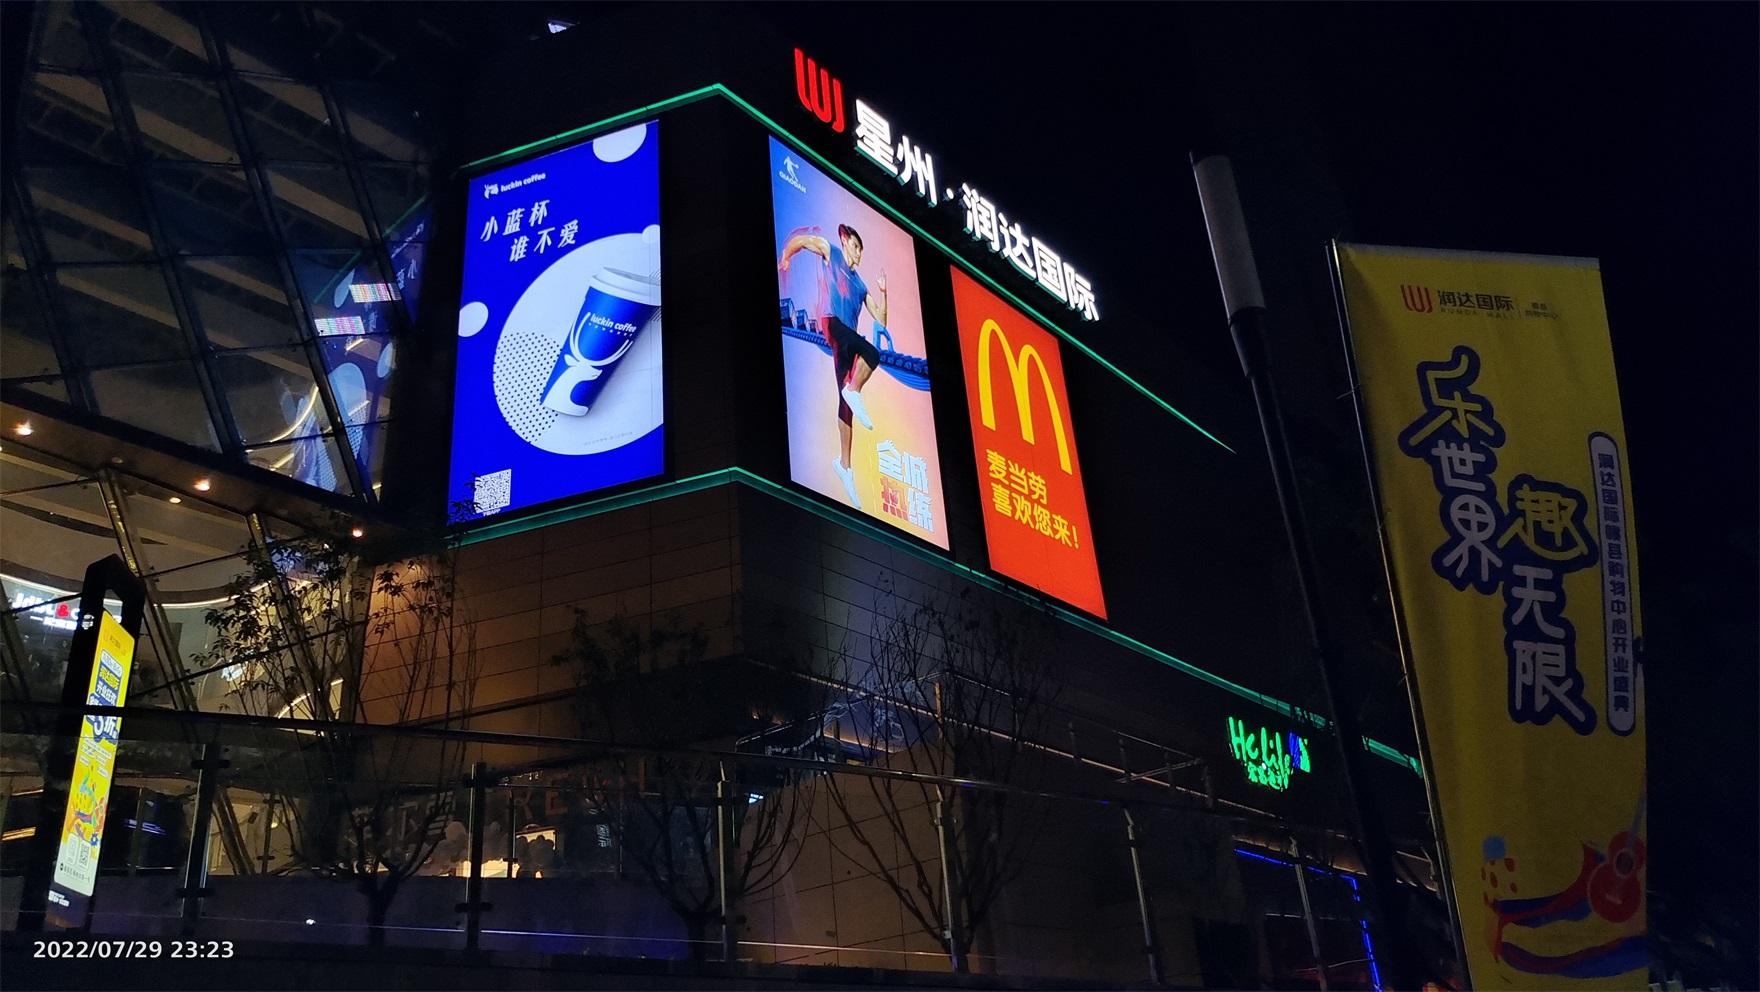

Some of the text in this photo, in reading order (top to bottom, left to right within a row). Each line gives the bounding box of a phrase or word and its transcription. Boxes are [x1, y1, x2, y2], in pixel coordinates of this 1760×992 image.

[501, 178, 523, 193] luckin
[480, 200, 551, 242] 小蓝杯
[509, 219, 580, 262] 谁不爱
[590, 313, 614, 329] luckin
[1437, 290, 1514, 311] 润达国际
[986, 449, 1047, 505] 麦当劳
[1408, 353, 1503, 582] 乐世界
[1497, 483, 1590, 722] 趣无限
